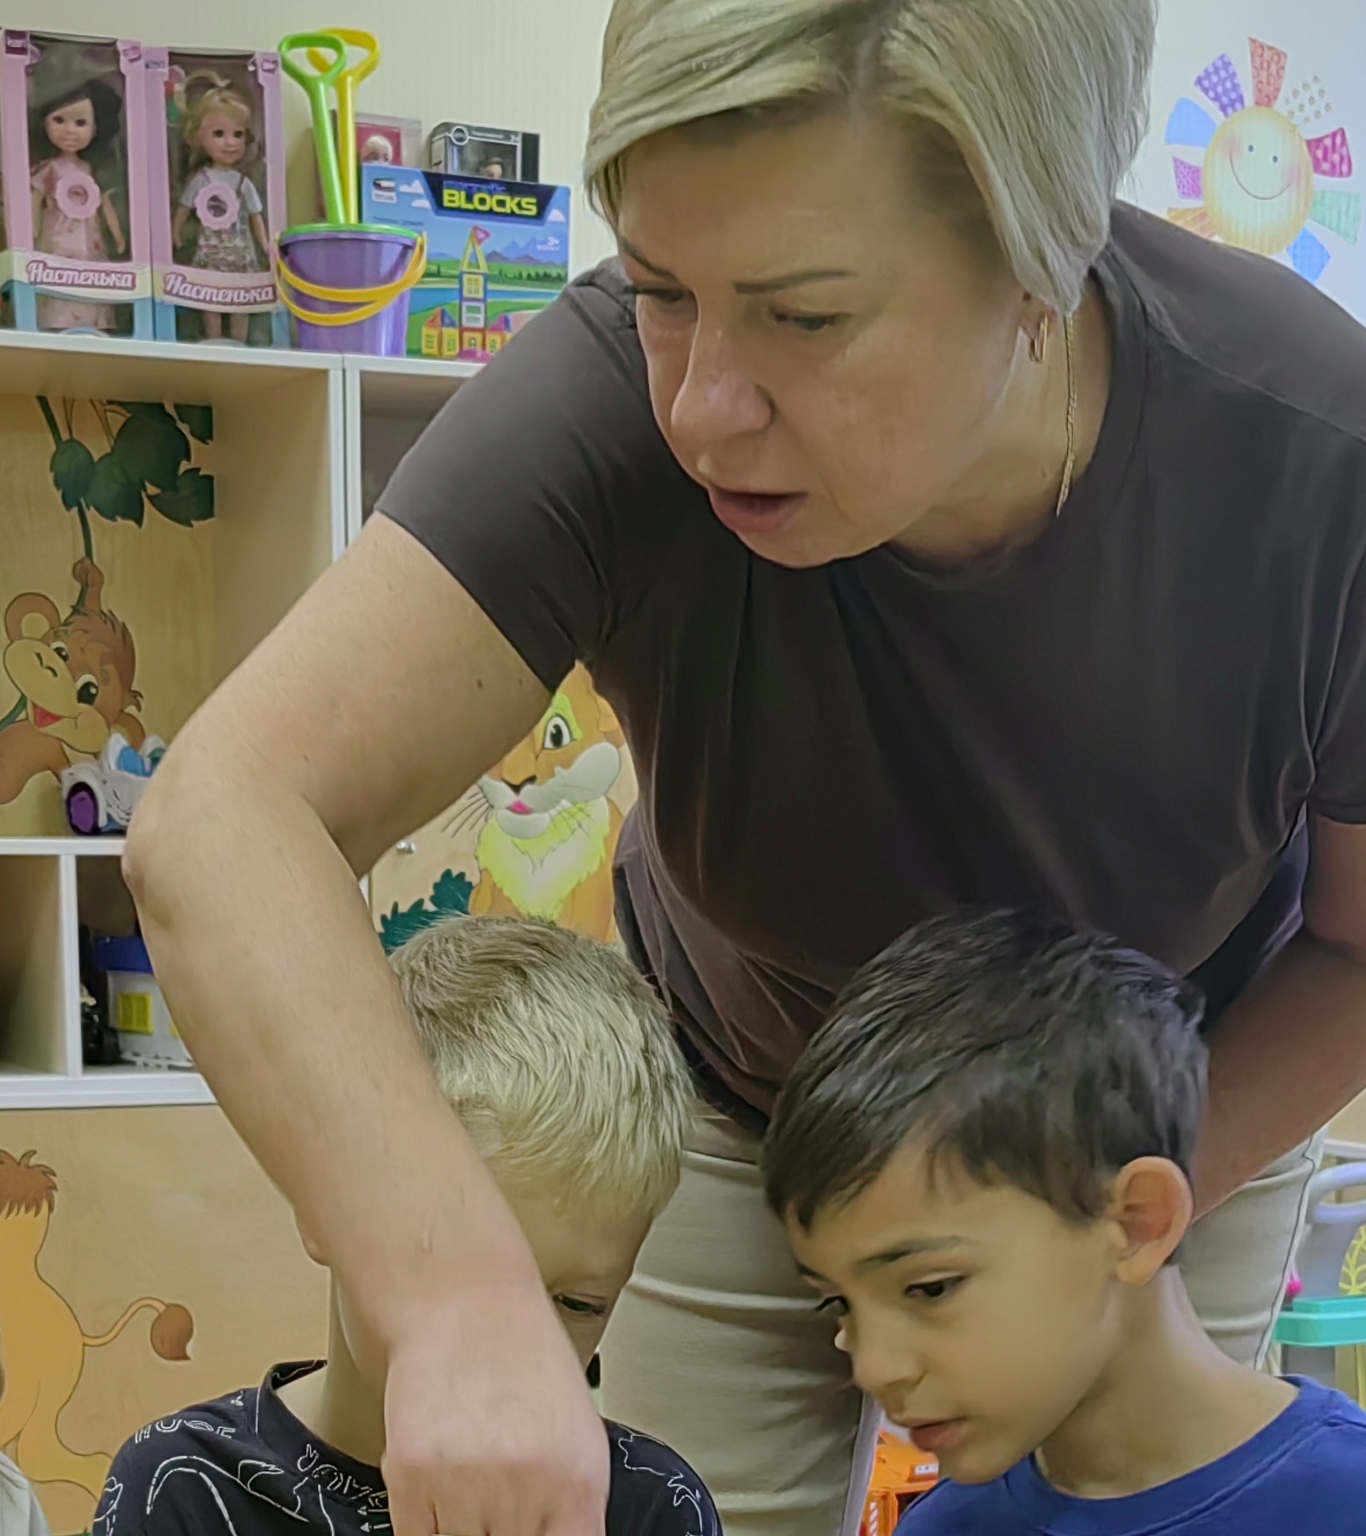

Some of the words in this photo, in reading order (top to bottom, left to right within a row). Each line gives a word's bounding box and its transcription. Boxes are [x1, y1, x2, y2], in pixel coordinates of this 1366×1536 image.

[442, 188, 538, 216] BLOCKS
[26, 261, 133, 288] Настенька
[164, 273, 274, 303] Настенька
